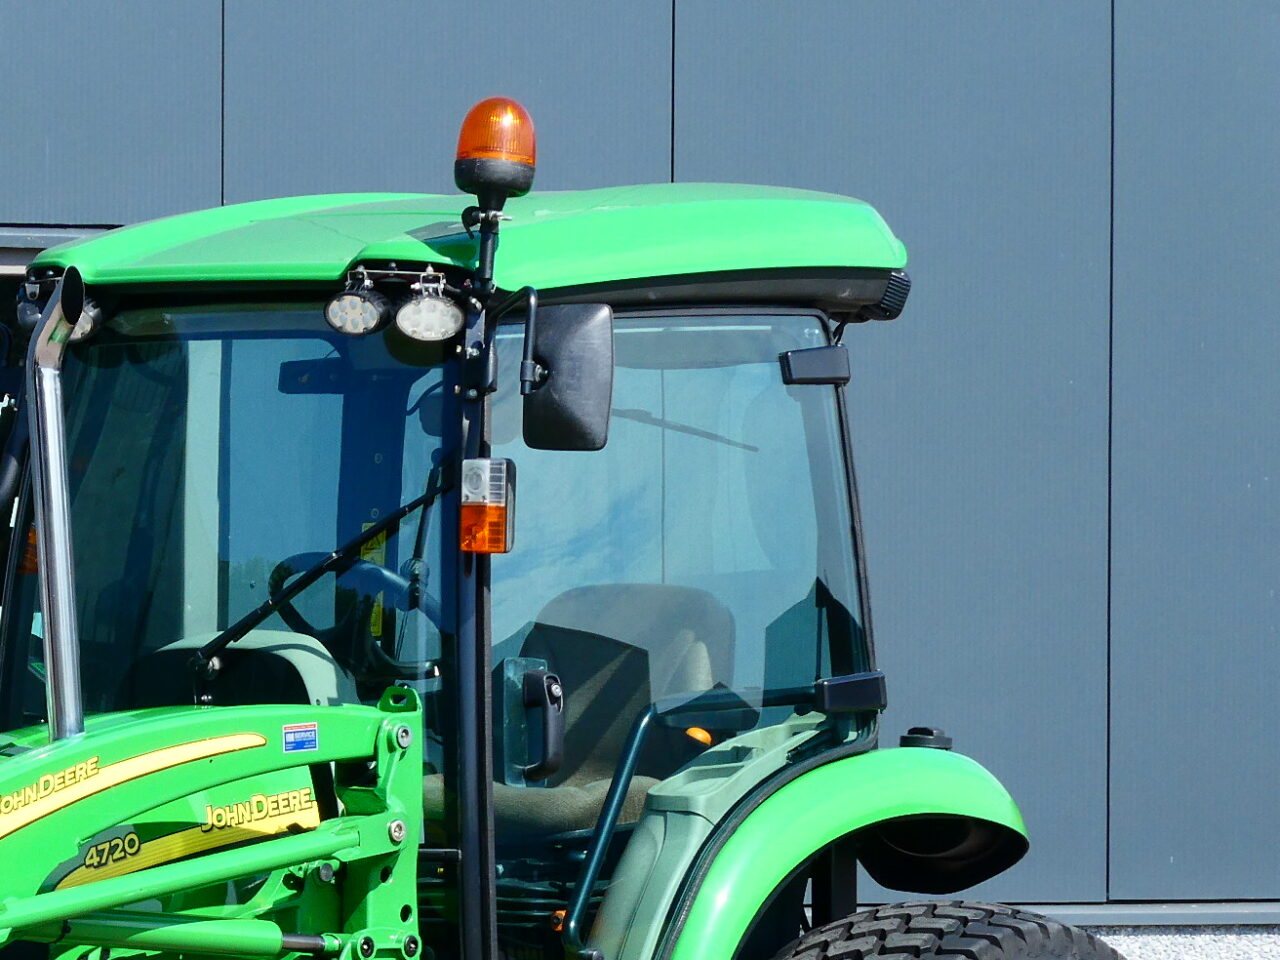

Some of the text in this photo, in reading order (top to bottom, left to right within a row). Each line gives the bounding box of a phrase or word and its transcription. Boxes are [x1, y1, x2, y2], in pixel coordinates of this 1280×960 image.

[39, 756, 100, 800] DEERE
[201, 787, 312, 833] JOHN DEERE
[84, 832, 140, 869] 4720
